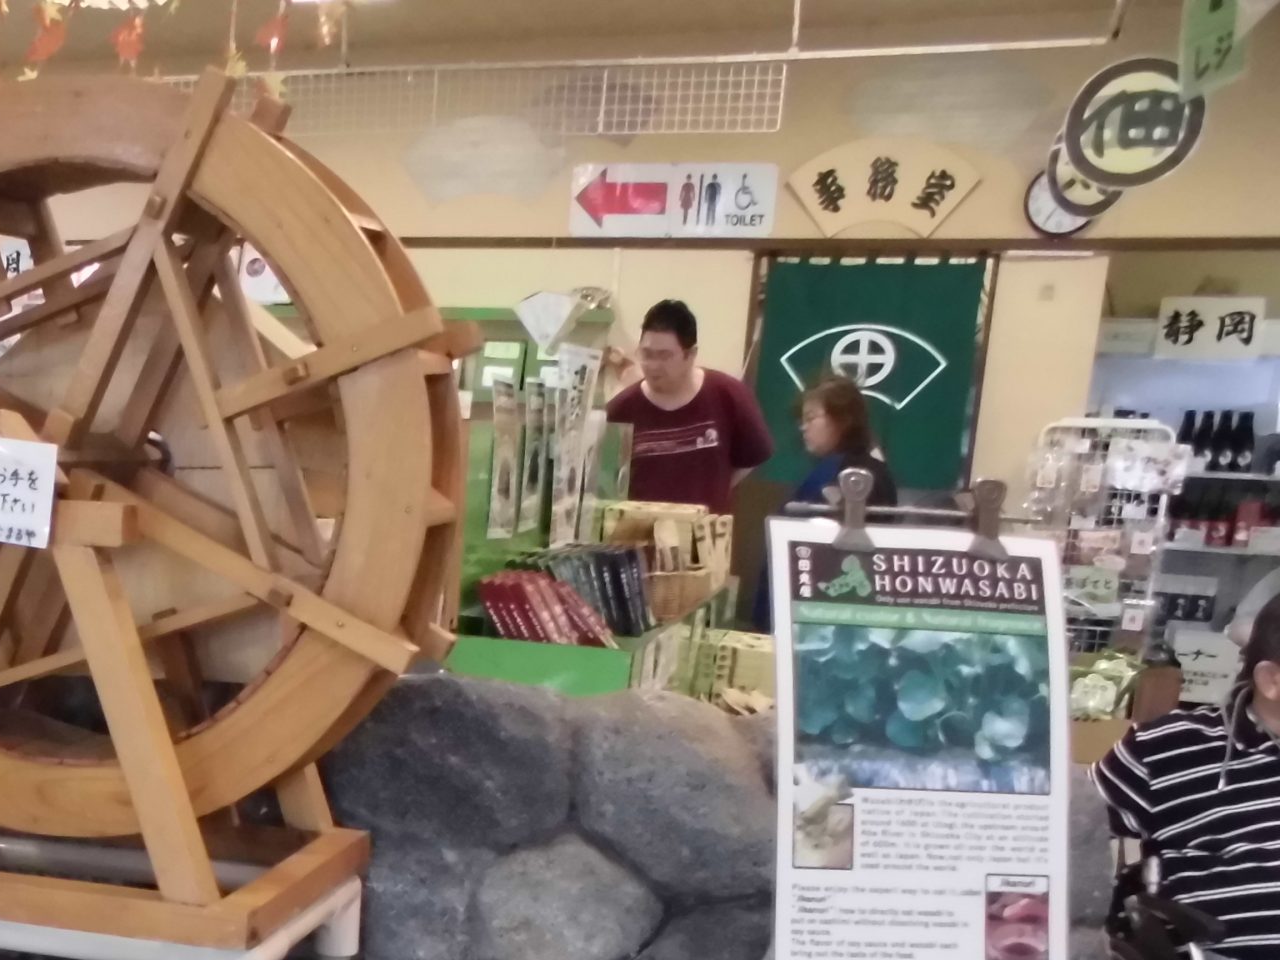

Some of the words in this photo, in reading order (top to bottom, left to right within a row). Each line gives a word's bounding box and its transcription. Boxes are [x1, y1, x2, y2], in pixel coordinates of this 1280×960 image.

[724, 213, 765, 227] TOILET
[1162, 309, 1257, 346] 静岡
[872, 553, 1034, 581] SHIZUOKA
[873, 574, 1040, 601] HONWASABI
